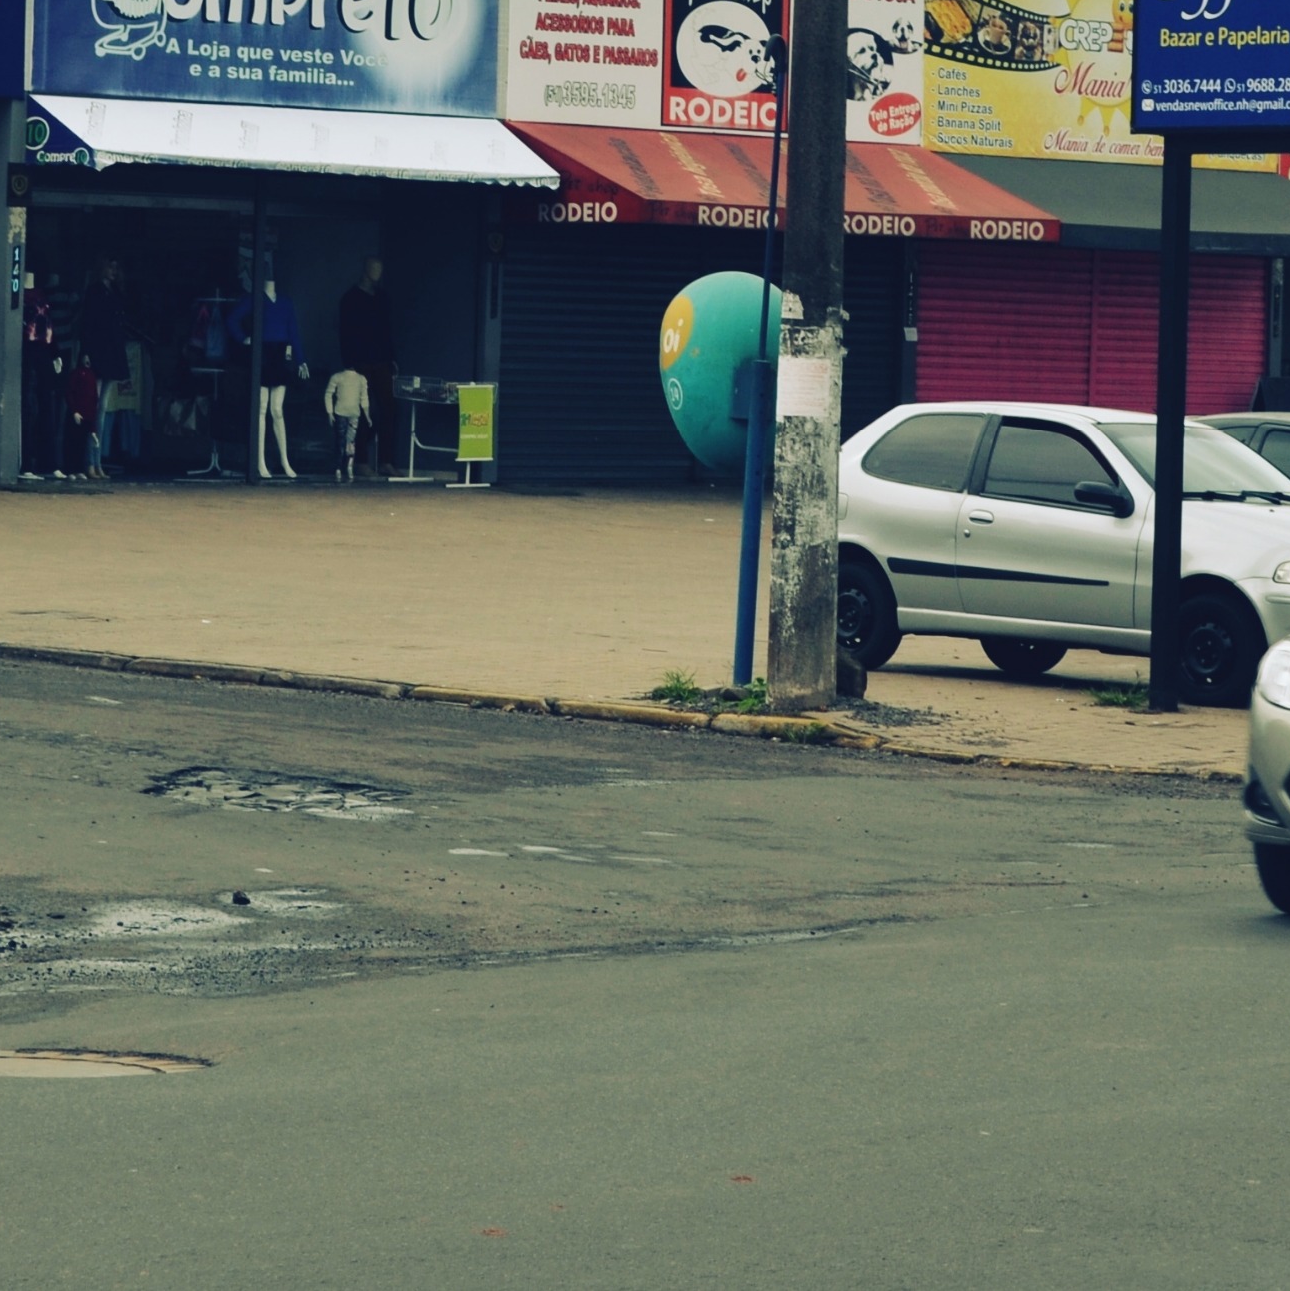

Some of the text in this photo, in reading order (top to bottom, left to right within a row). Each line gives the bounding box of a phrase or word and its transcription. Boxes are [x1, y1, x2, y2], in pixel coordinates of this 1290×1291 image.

[607, 17, 635, 37] PARA
[1160, 26, 1290, 50] Bazar e Papelaria
[166, 38, 180, 54] A
[187, 39, 230, 62] Loja
[237, 46, 273, 62] que
[280, 46, 334, 64] veste
[555, 43, 590, 63] GATOS
[593, 45, 600, 63] E
[603, 45, 658, 67] PASSAROS
[189, 63, 355, 86] e a sua familia...
[1054, 62, 1126, 98] Mania
[938, 85, 980, 98] Lanches
[1153, 85, 1162, 94] 51
[1163, 79, 1221, 94] 3036.7444
[1236, 84, 1245, 93] 51
[669, 95, 778, 127] RODEIO
[870, 109, 888, 121] Tele
[937, 100, 993, 115] Mini Pizzas
[937, 116, 1002, 132] Banana Split
[937, 132, 1014, 149] Sucos Naturais
[1044, 130, 1088, 152] Mania
[1092, 135, 1106, 154] de
[1109, 142, 1141, 156] comer
[538, 201, 618, 223] RODEIO
[698, 205, 779, 229] RODEIO
[844, 213, 916, 236] RODEIO
[970, 220, 1044, 242] RODEIO
